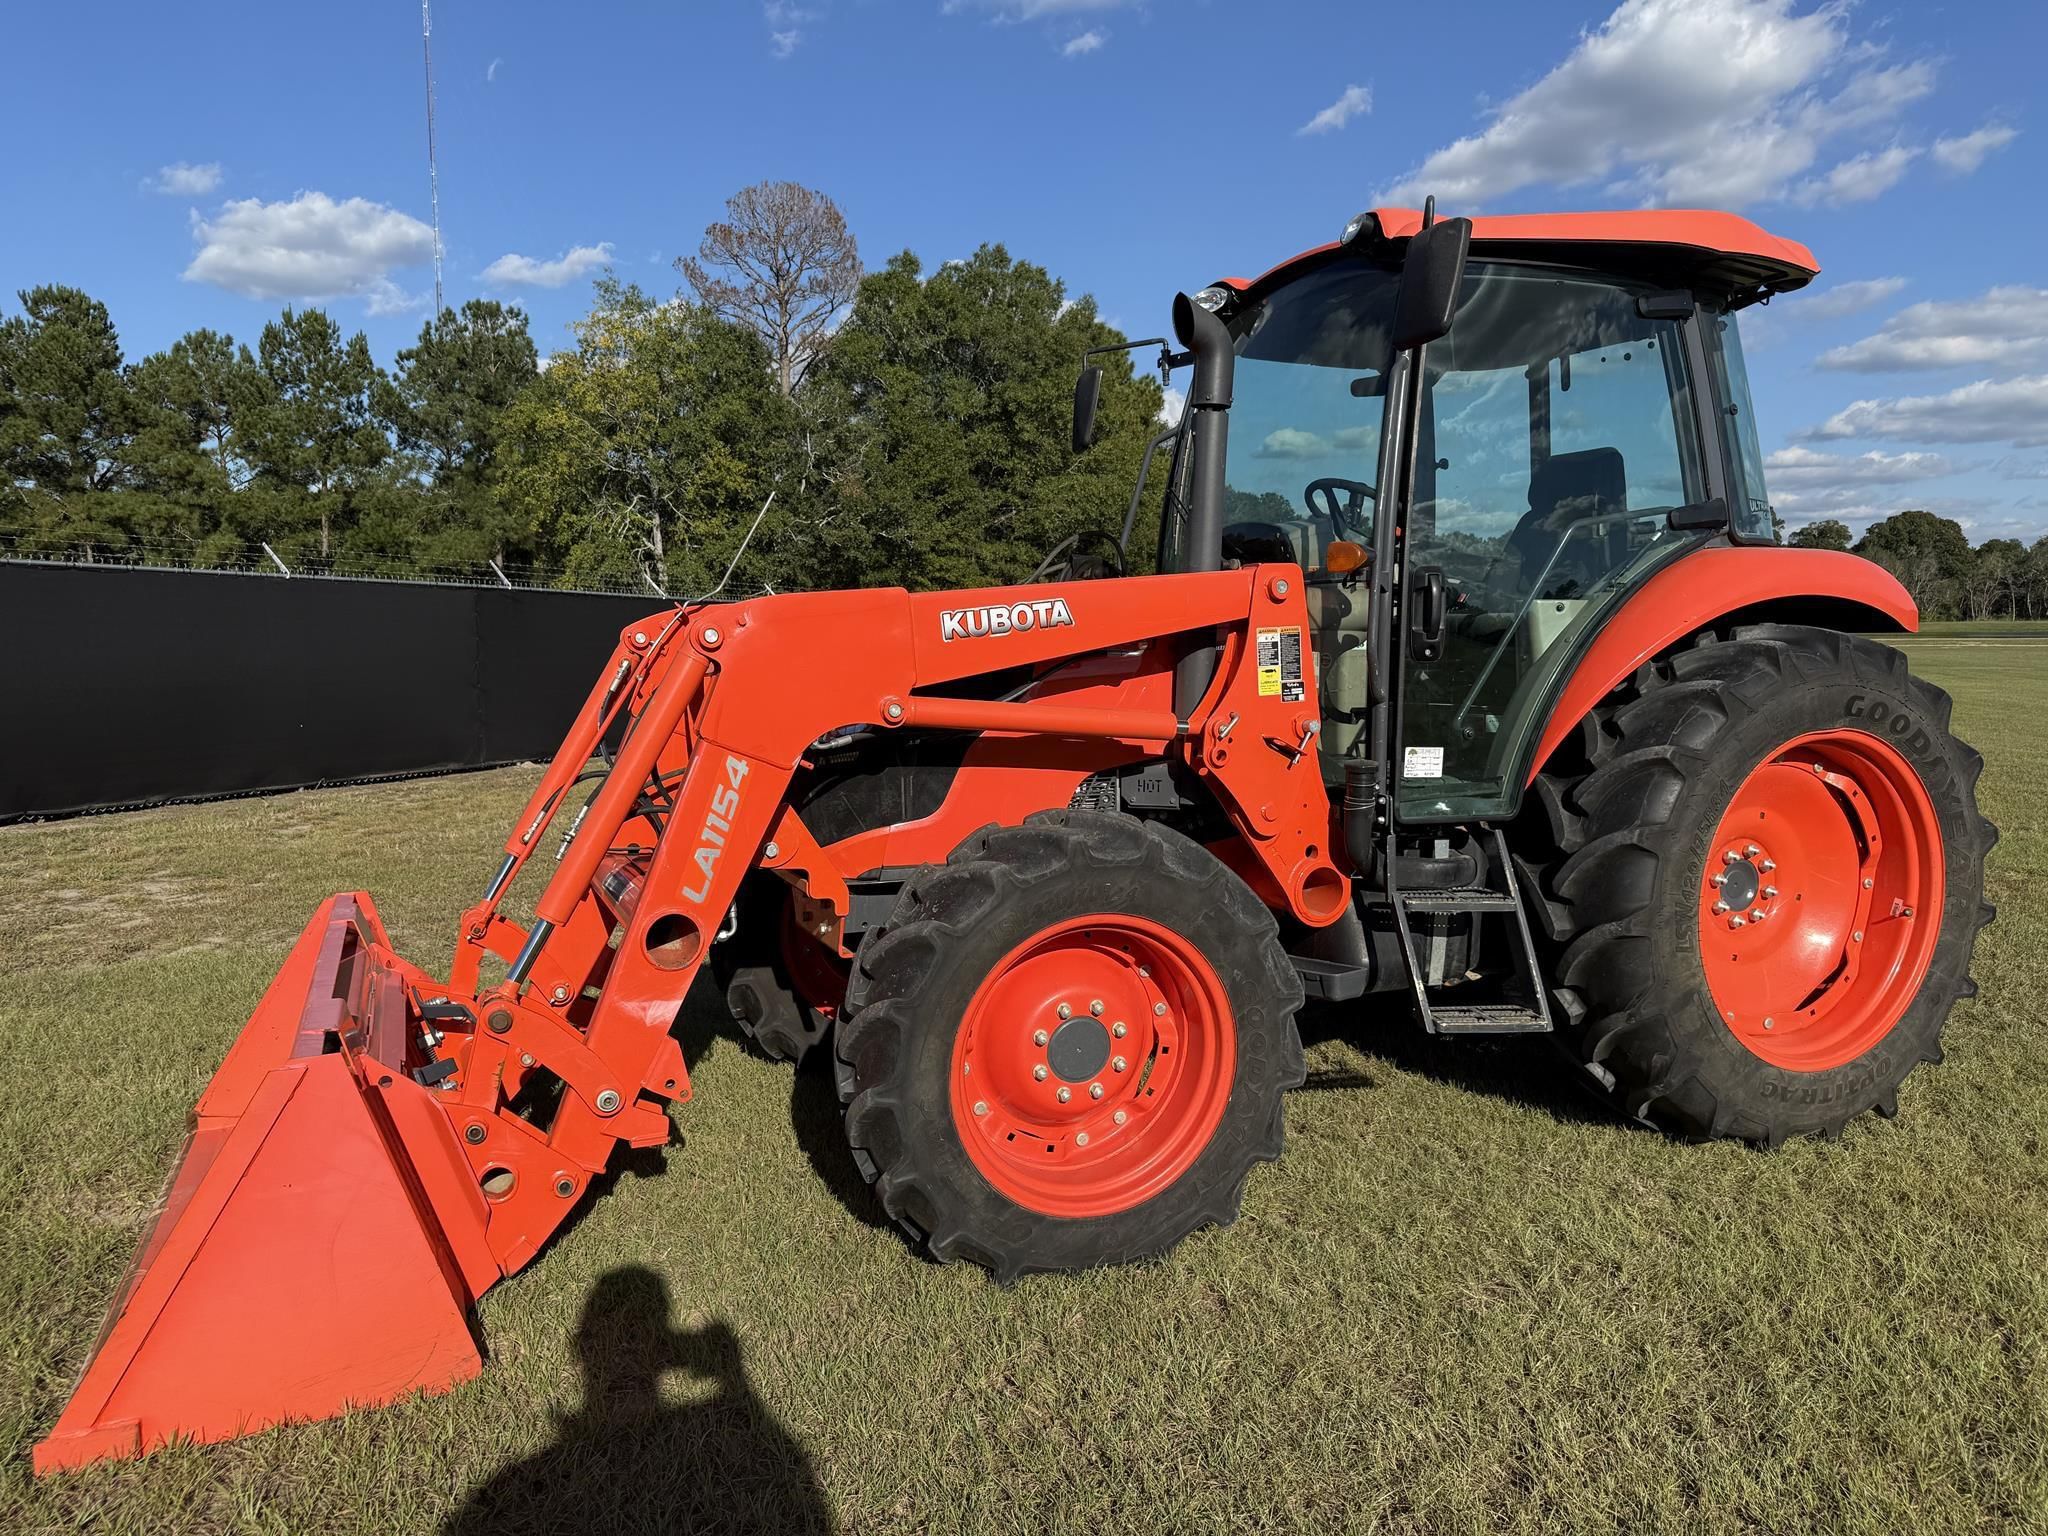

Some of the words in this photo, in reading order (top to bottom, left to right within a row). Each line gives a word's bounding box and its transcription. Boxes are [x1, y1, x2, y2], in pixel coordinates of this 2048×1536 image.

[940, 598, 1075, 642] KUBOTA
[1137, 779, 1163, 793] HOT
[1843, 694, 1971, 918] GOODYEAR
[681, 755, 749, 904] LA1154
[1759, 1056, 1892, 1105] OPTITRAC
